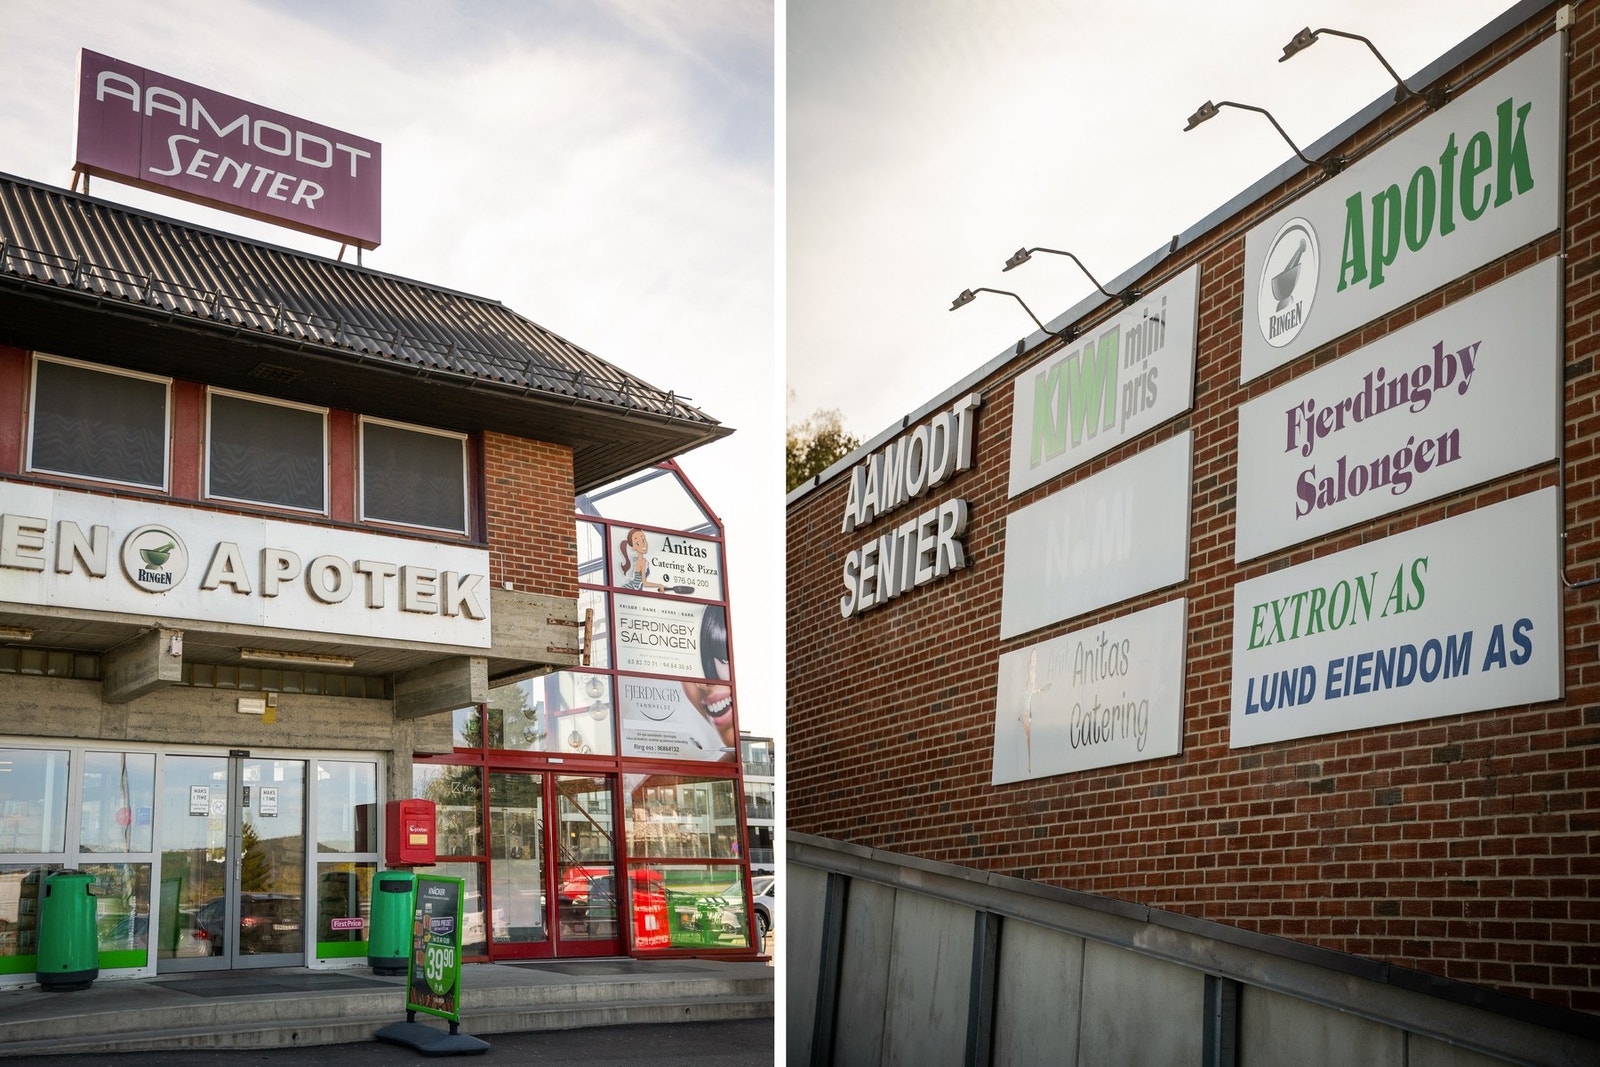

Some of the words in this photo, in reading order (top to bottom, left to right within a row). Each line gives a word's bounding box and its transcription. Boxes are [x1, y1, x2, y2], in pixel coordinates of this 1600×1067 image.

[96, 70, 371, 178] AAMODT
[149, 134, 325, 210] SENTER
[1336, 96, 1534, 293] Apotek
[1124, 295, 1167, 370] mini
[1268, 300, 1303, 340] RINGEN
[1030, 323, 1120, 470] KIWI
[1121, 359, 1159, 435] pris
[1284, 340, 1483, 458] Fjerdingby
[1295, 427, 1462, 521] Salongen
[138, 568, 172, 585] RINGEN
[200, 540, 487, 621] APOTEK
[651, 557, 685, 573] Catering
[687, 563, 695, 573] &
[697, 564, 718, 576] Pizza
[661, 536, 708, 559] Anitas
[840, 498, 968, 618] SENTER
[697, 578, 710, 588] 200
[1246, 571, 1379, 651] EXTRON
[1380, 555, 1429, 619] AS
[620, 617, 695, 636] FJERDINGBY
[621, 630, 697, 650] SALONGEN
[1073, 630, 1130, 689] Anitas
[624, 684, 681, 703] FJERDINGBY
[1244, 664, 1317, 716] LUND
[1324, 630, 1474, 701] EIENDOM
[1482, 617, 1535, 673] AS
[633, 743, 645, 751] Ring
[1070, 691, 1149, 753] Catering
[333, 920, 347, 928] First
[347, 919, 362, 927] Price
